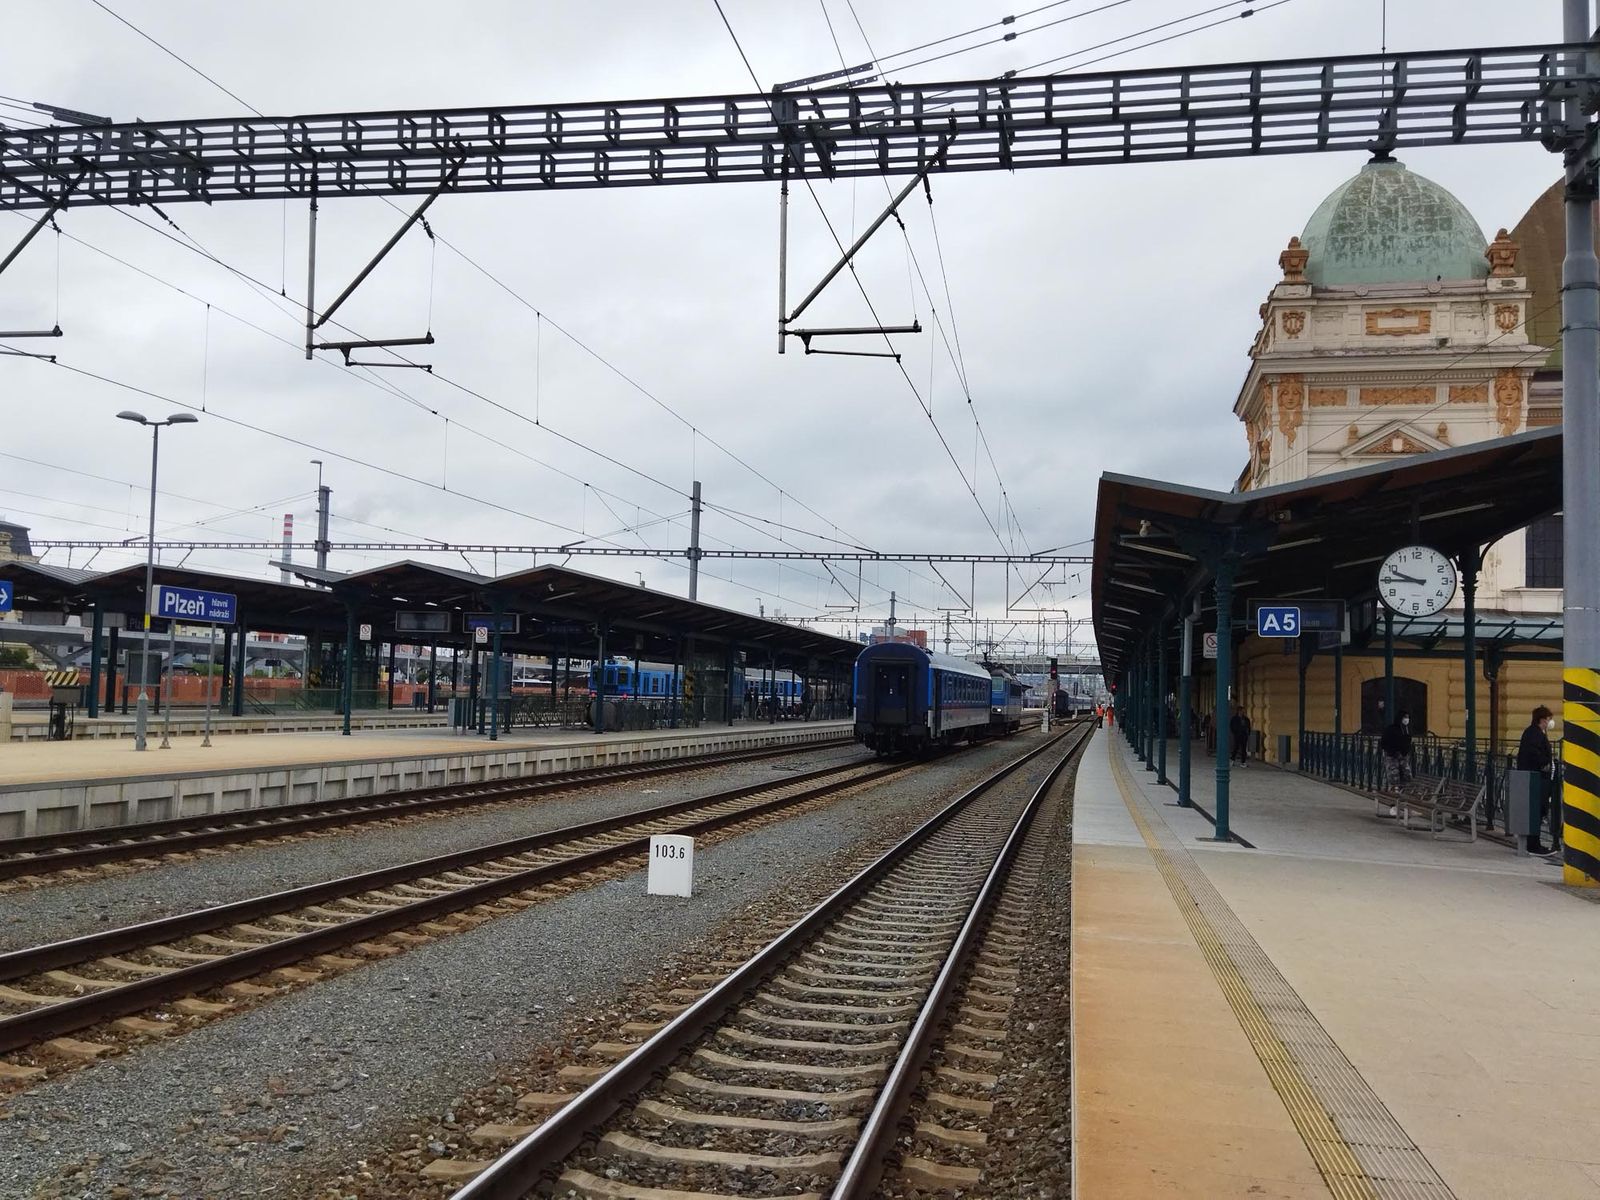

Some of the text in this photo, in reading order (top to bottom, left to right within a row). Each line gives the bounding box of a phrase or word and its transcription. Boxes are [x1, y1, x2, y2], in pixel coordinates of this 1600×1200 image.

[1399, 555, 1407, 563] 11
[1411, 551, 1422, 560] 12
[1430, 555, 1434, 563] 1
[1388, 564, 1398, 573] 10
[1437, 565, 1445, 573] 2
[1384, 576, 1392, 584] 9
[1441, 577, 1449, 585] 3
[1389, 588, 1396, 597] 8
[1435, 589, 1443, 597] 4
[164, 591, 205, 616] Plzeň
[211, 598, 229, 608] hlavní
[1399, 598, 1406, 606] 7
[1412, 602, 1420, 611] 6
[1426, 598, 1434, 607] 5
[208, 609, 230, 619] nádraží
[655, 844, 685, 859] 103.6
